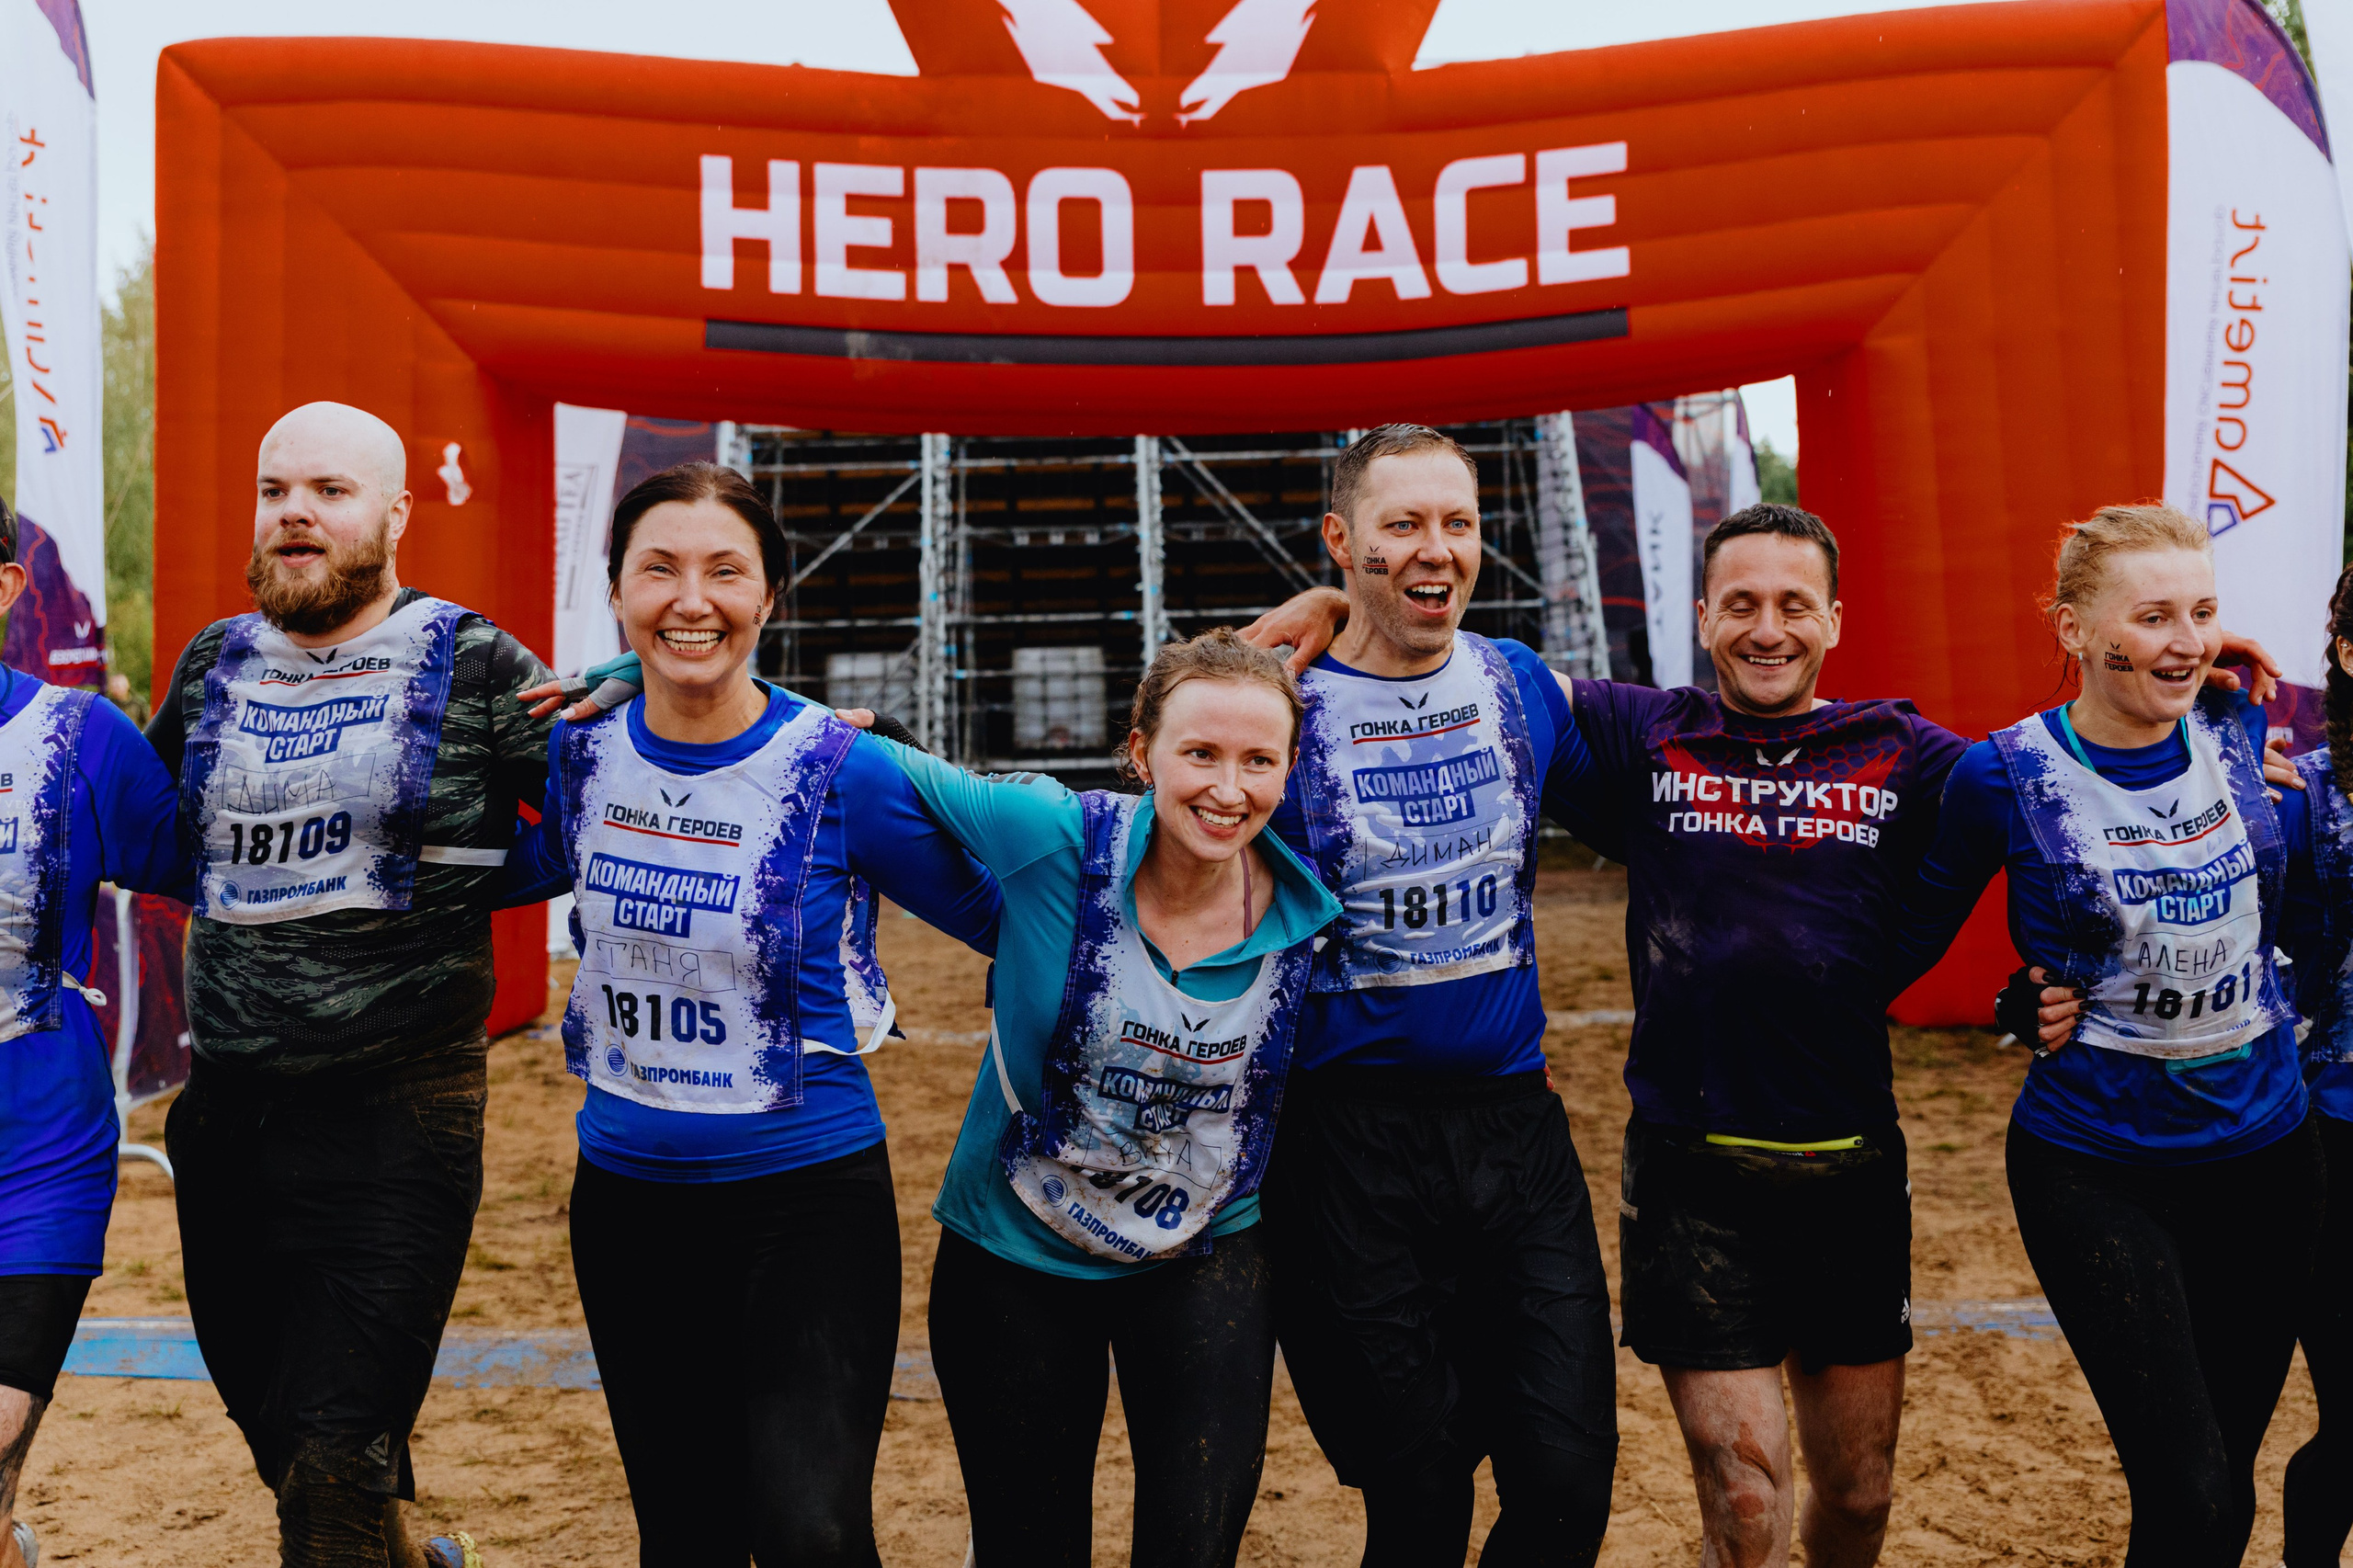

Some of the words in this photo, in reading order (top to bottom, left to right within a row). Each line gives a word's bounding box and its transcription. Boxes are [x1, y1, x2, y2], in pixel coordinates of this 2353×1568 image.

[699, 153, 1134, 307] HERO
[1200, 141, 1631, 306] RACE
[2105, 652, 2130, 662] ГОНКА
[2105, 662, 2134, 672] ГЕРОЕВ
[244, 694, 385, 733] КОМАНДНЫЙ
[1350, 720, 1413, 739] ГОНКА
[1417, 703, 1479, 732] ГЕРОЕВ
[268, 728, 337, 760] СТАРТ
[227, 769, 337, 814] ДИМА
[1356, 747, 1497, 798] КОМАНДНЫЙ
[1404, 792, 1468, 824] СТАРТ
[1652, 771, 1899, 820] ИНСТРУКТОР
[230, 811, 352, 866] 18109
[605, 802, 660, 829] ГОНКА
[666, 815, 743, 840] ГЕРОЕВ
[1668, 812, 1768, 835] ГОНКА
[1778, 816, 1880, 848] ГЕРОЕВ
[2102, 824, 2167, 842] ГОНКА
[1381, 827, 1492, 869] ДИМАН
[246, 875, 347, 904] ГАЗПРОМБАНК
[588, 858, 736, 907] КОМАНДНЫЙ
[618, 898, 687, 934] СТАРТ
[1380, 874, 1496, 930] 18110
[2161, 889, 2226, 923] СТАРТ
[596, 938, 702, 986] ТАНЯ
[1410, 937, 1500, 965] ГАЗПРОМБАНК
[2138, 938, 2228, 975] АЛЕНА
[2132, 961, 2251, 1020] 18101
[601, 984, 726, 1045] 18105
[1121, 1020, 1180, 1052] ГОНКА
[1187, 1035, 1247, 1058] ГЕРОЕВ
[631, 1061, 733, 1088] ГАЗПРОМБАНК
